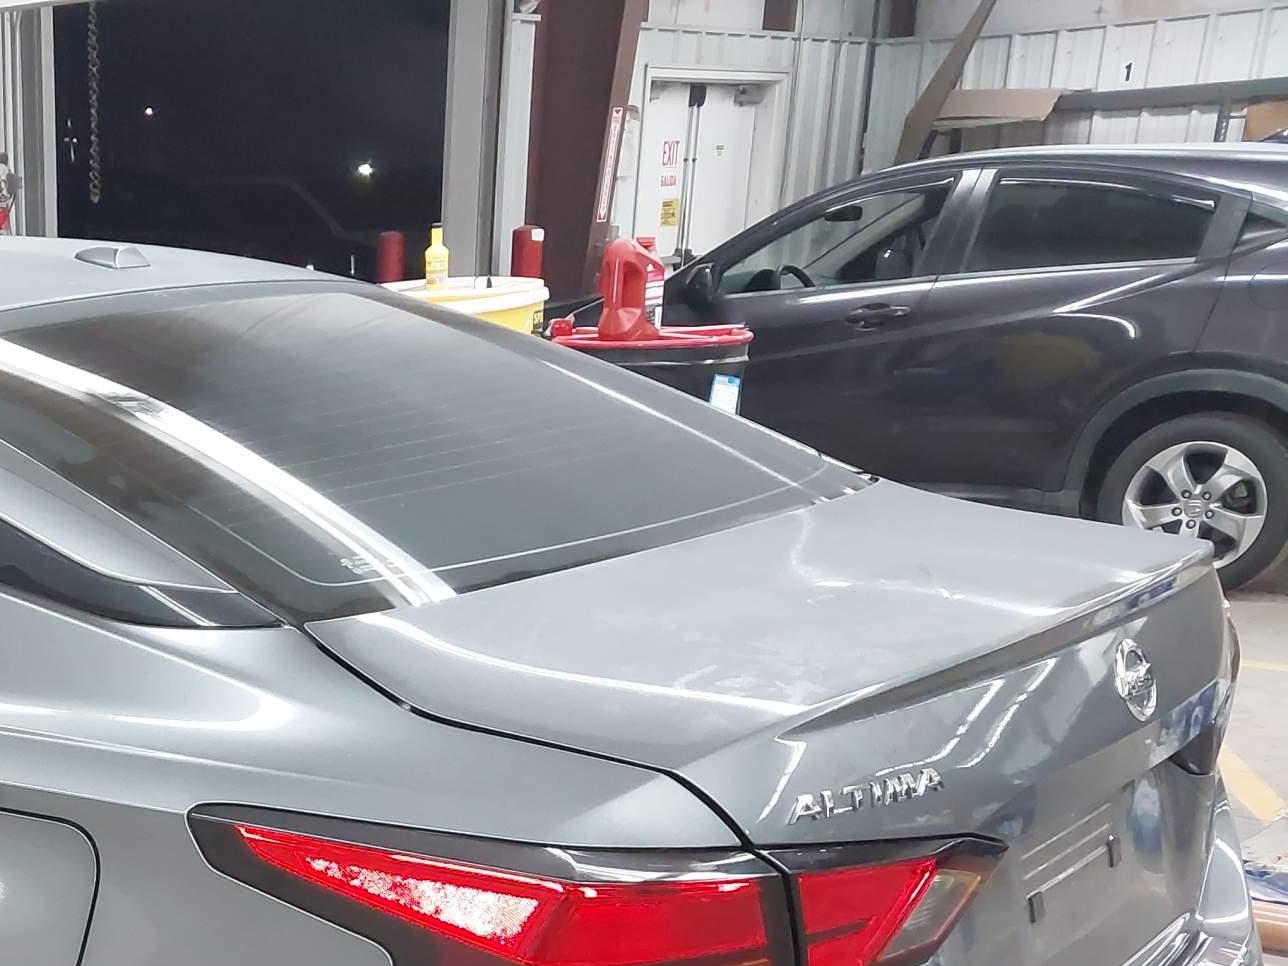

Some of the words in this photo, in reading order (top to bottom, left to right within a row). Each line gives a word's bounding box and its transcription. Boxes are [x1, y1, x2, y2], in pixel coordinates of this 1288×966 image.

[1124, 61, 1133, 82] 1
[662, 140, 680, 166] EXIT
[660, 175, 677, 187] SALIDA
[785, 767, 944, 825] ALTIMA
